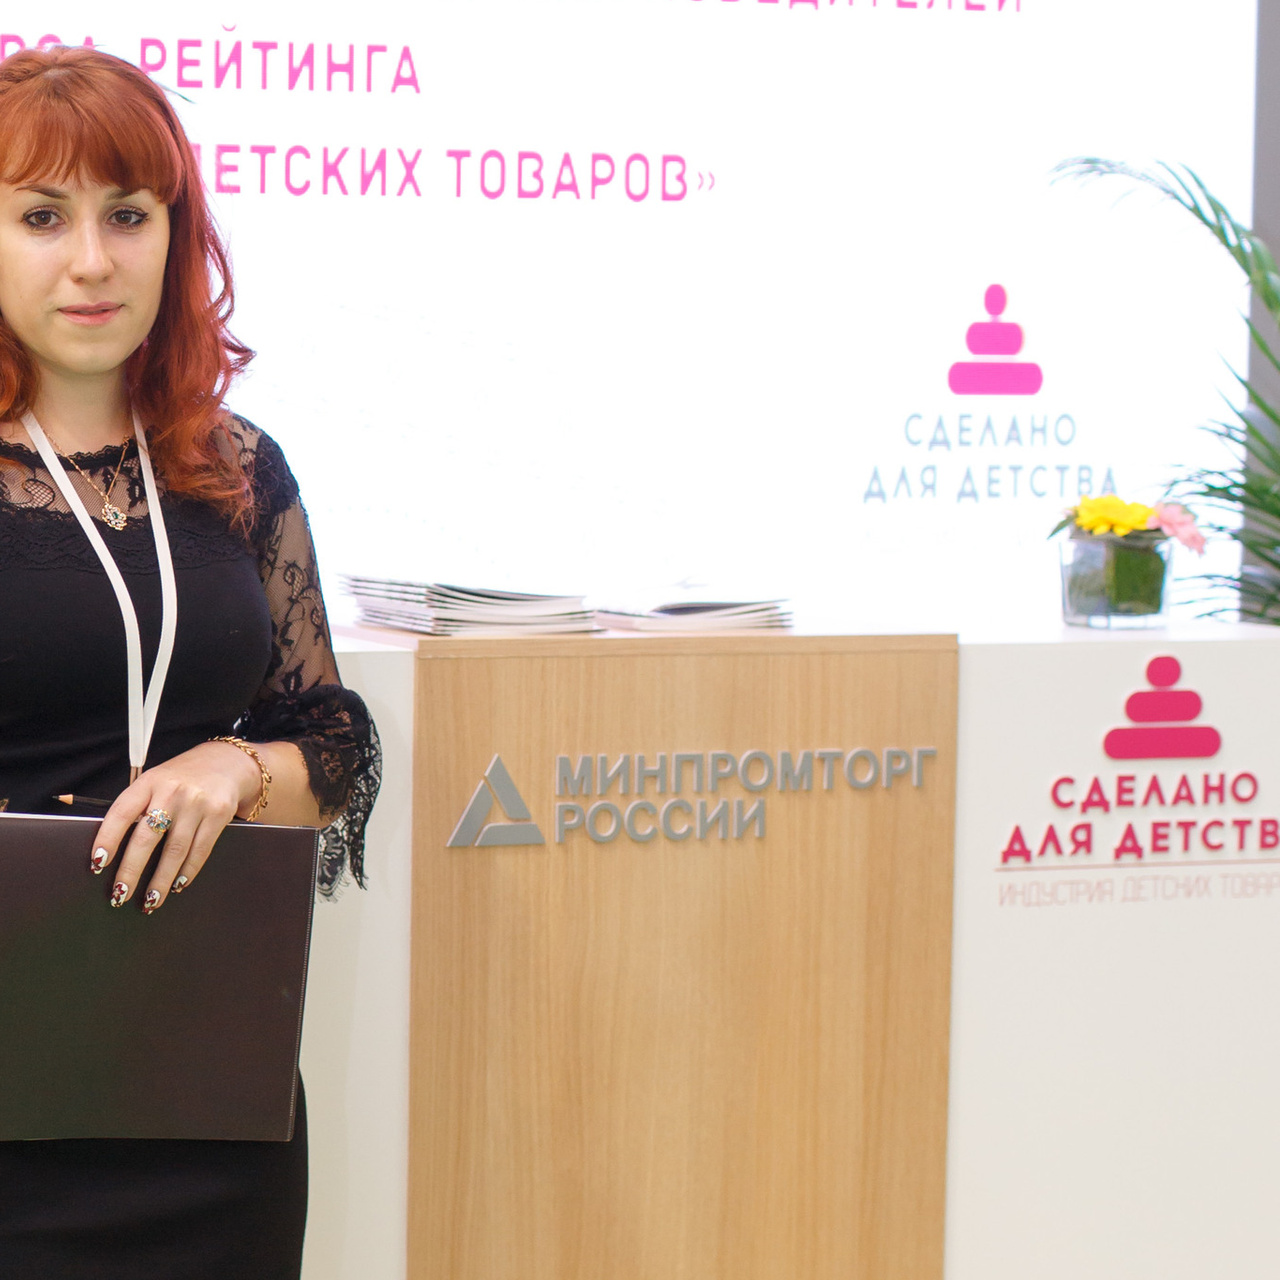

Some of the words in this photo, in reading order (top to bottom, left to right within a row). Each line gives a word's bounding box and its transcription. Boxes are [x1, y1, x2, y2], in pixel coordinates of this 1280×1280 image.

[140, 23, 422, 95] РЕЙТИНГА
[190, 143, 423, 198] ЕТСКИХ
[445, 149, 716, 204] ТОВАРОВ»
[904, 413, 1077, 451] СДЕЛАНО
[863, 465, 938, 504] ДЛЯ
[956, 465, 1118, 503] ДЕТСТВА
[555, 746, 938, 796] МИНПРОМТОРГ
[1050, 772, 1259, 815] СДЕЛАНО
[554, 797, 767, 845] РОССИИ
[1001, 823, 1094, 865] ДЛЯ
[998, 877, 1115, 908] ИНДУСТРИЯ
